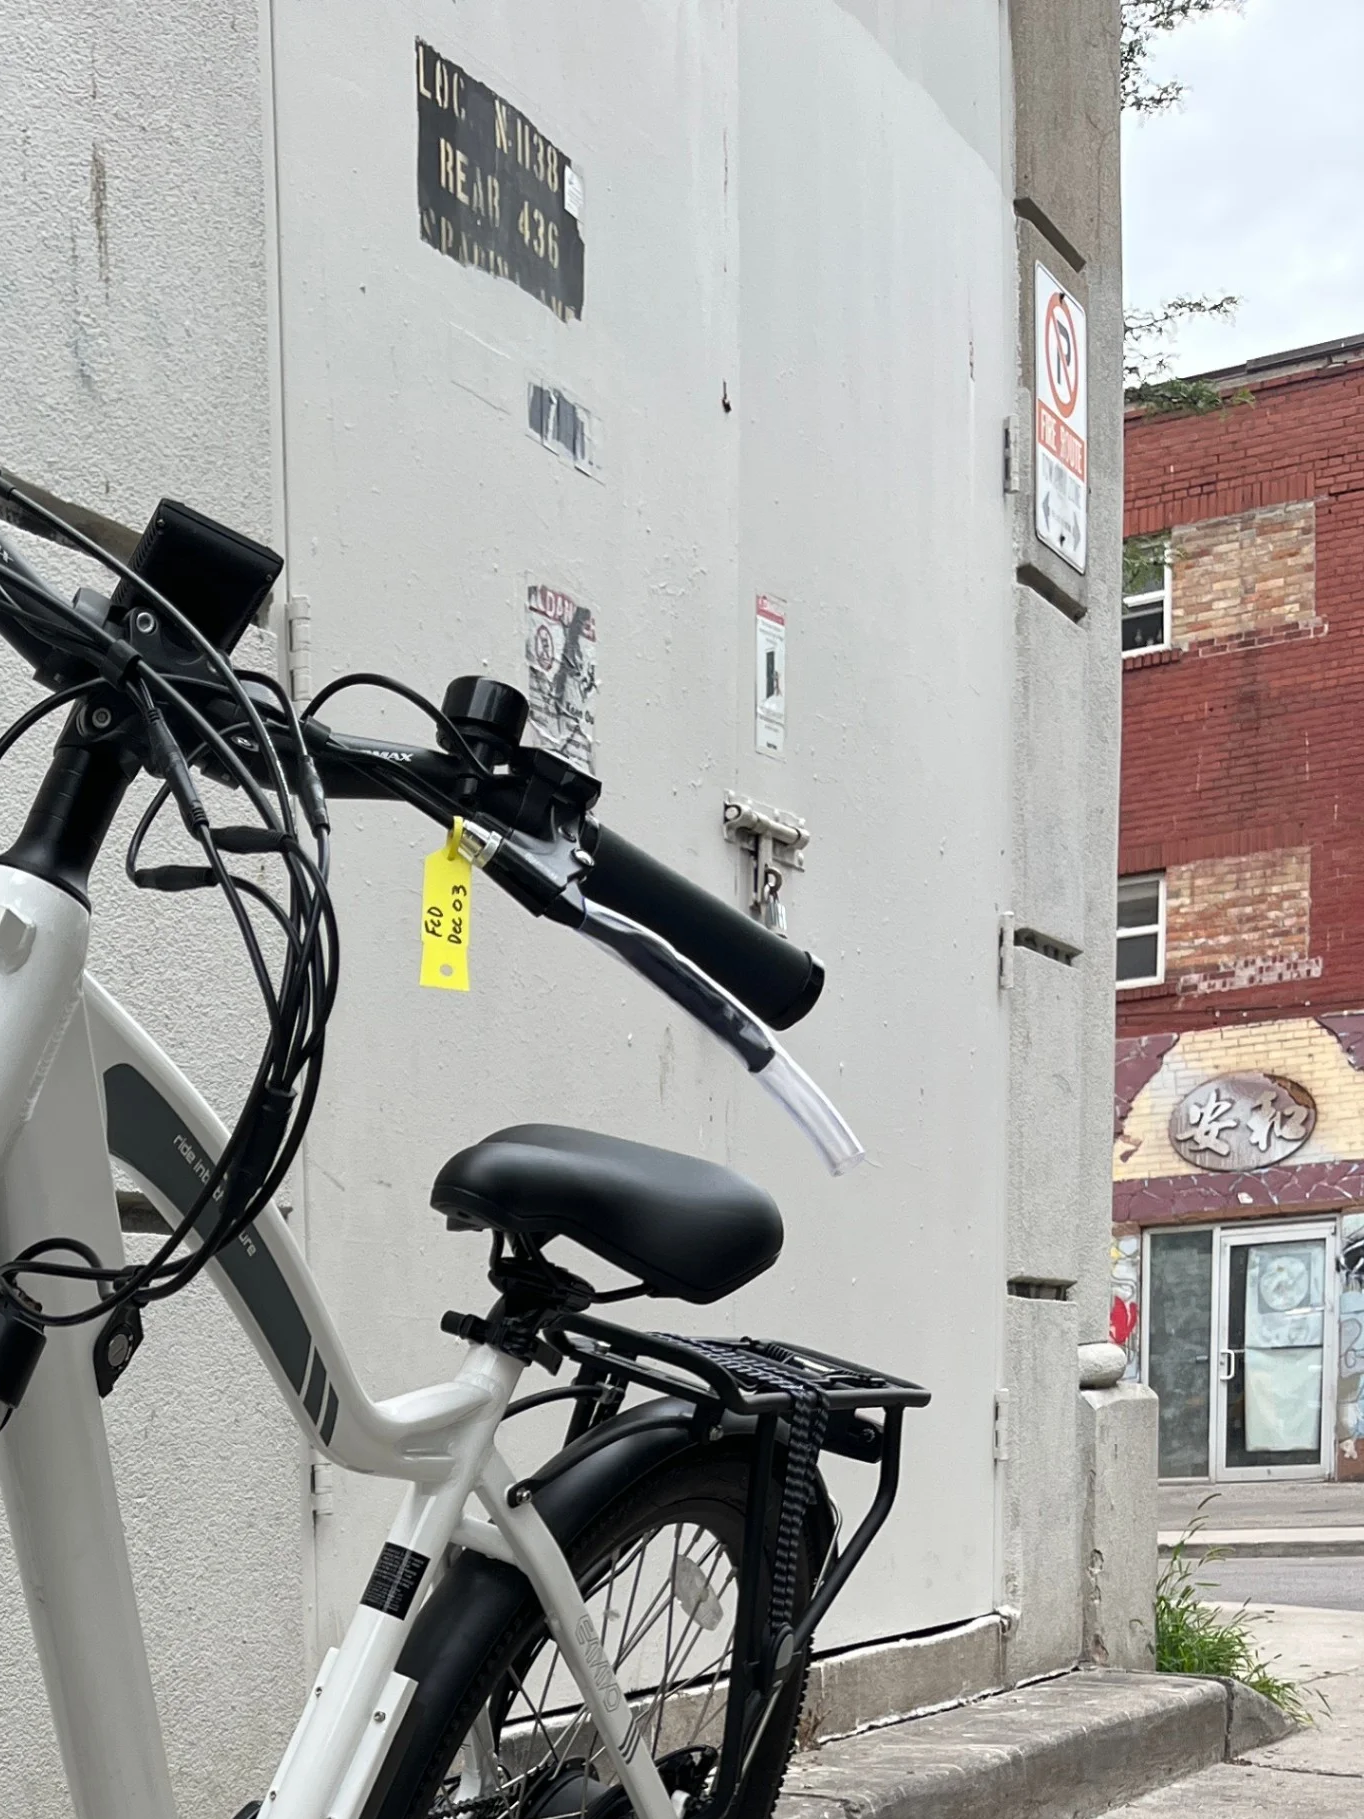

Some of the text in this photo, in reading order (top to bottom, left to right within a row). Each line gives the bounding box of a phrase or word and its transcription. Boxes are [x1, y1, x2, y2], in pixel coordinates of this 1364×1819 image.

[419, 45, 466, 121] LOC
[440, 137, 502, 228] REAR
[518, 201, 561, 269] 436
[173, 1134, 196, 1165] ride
